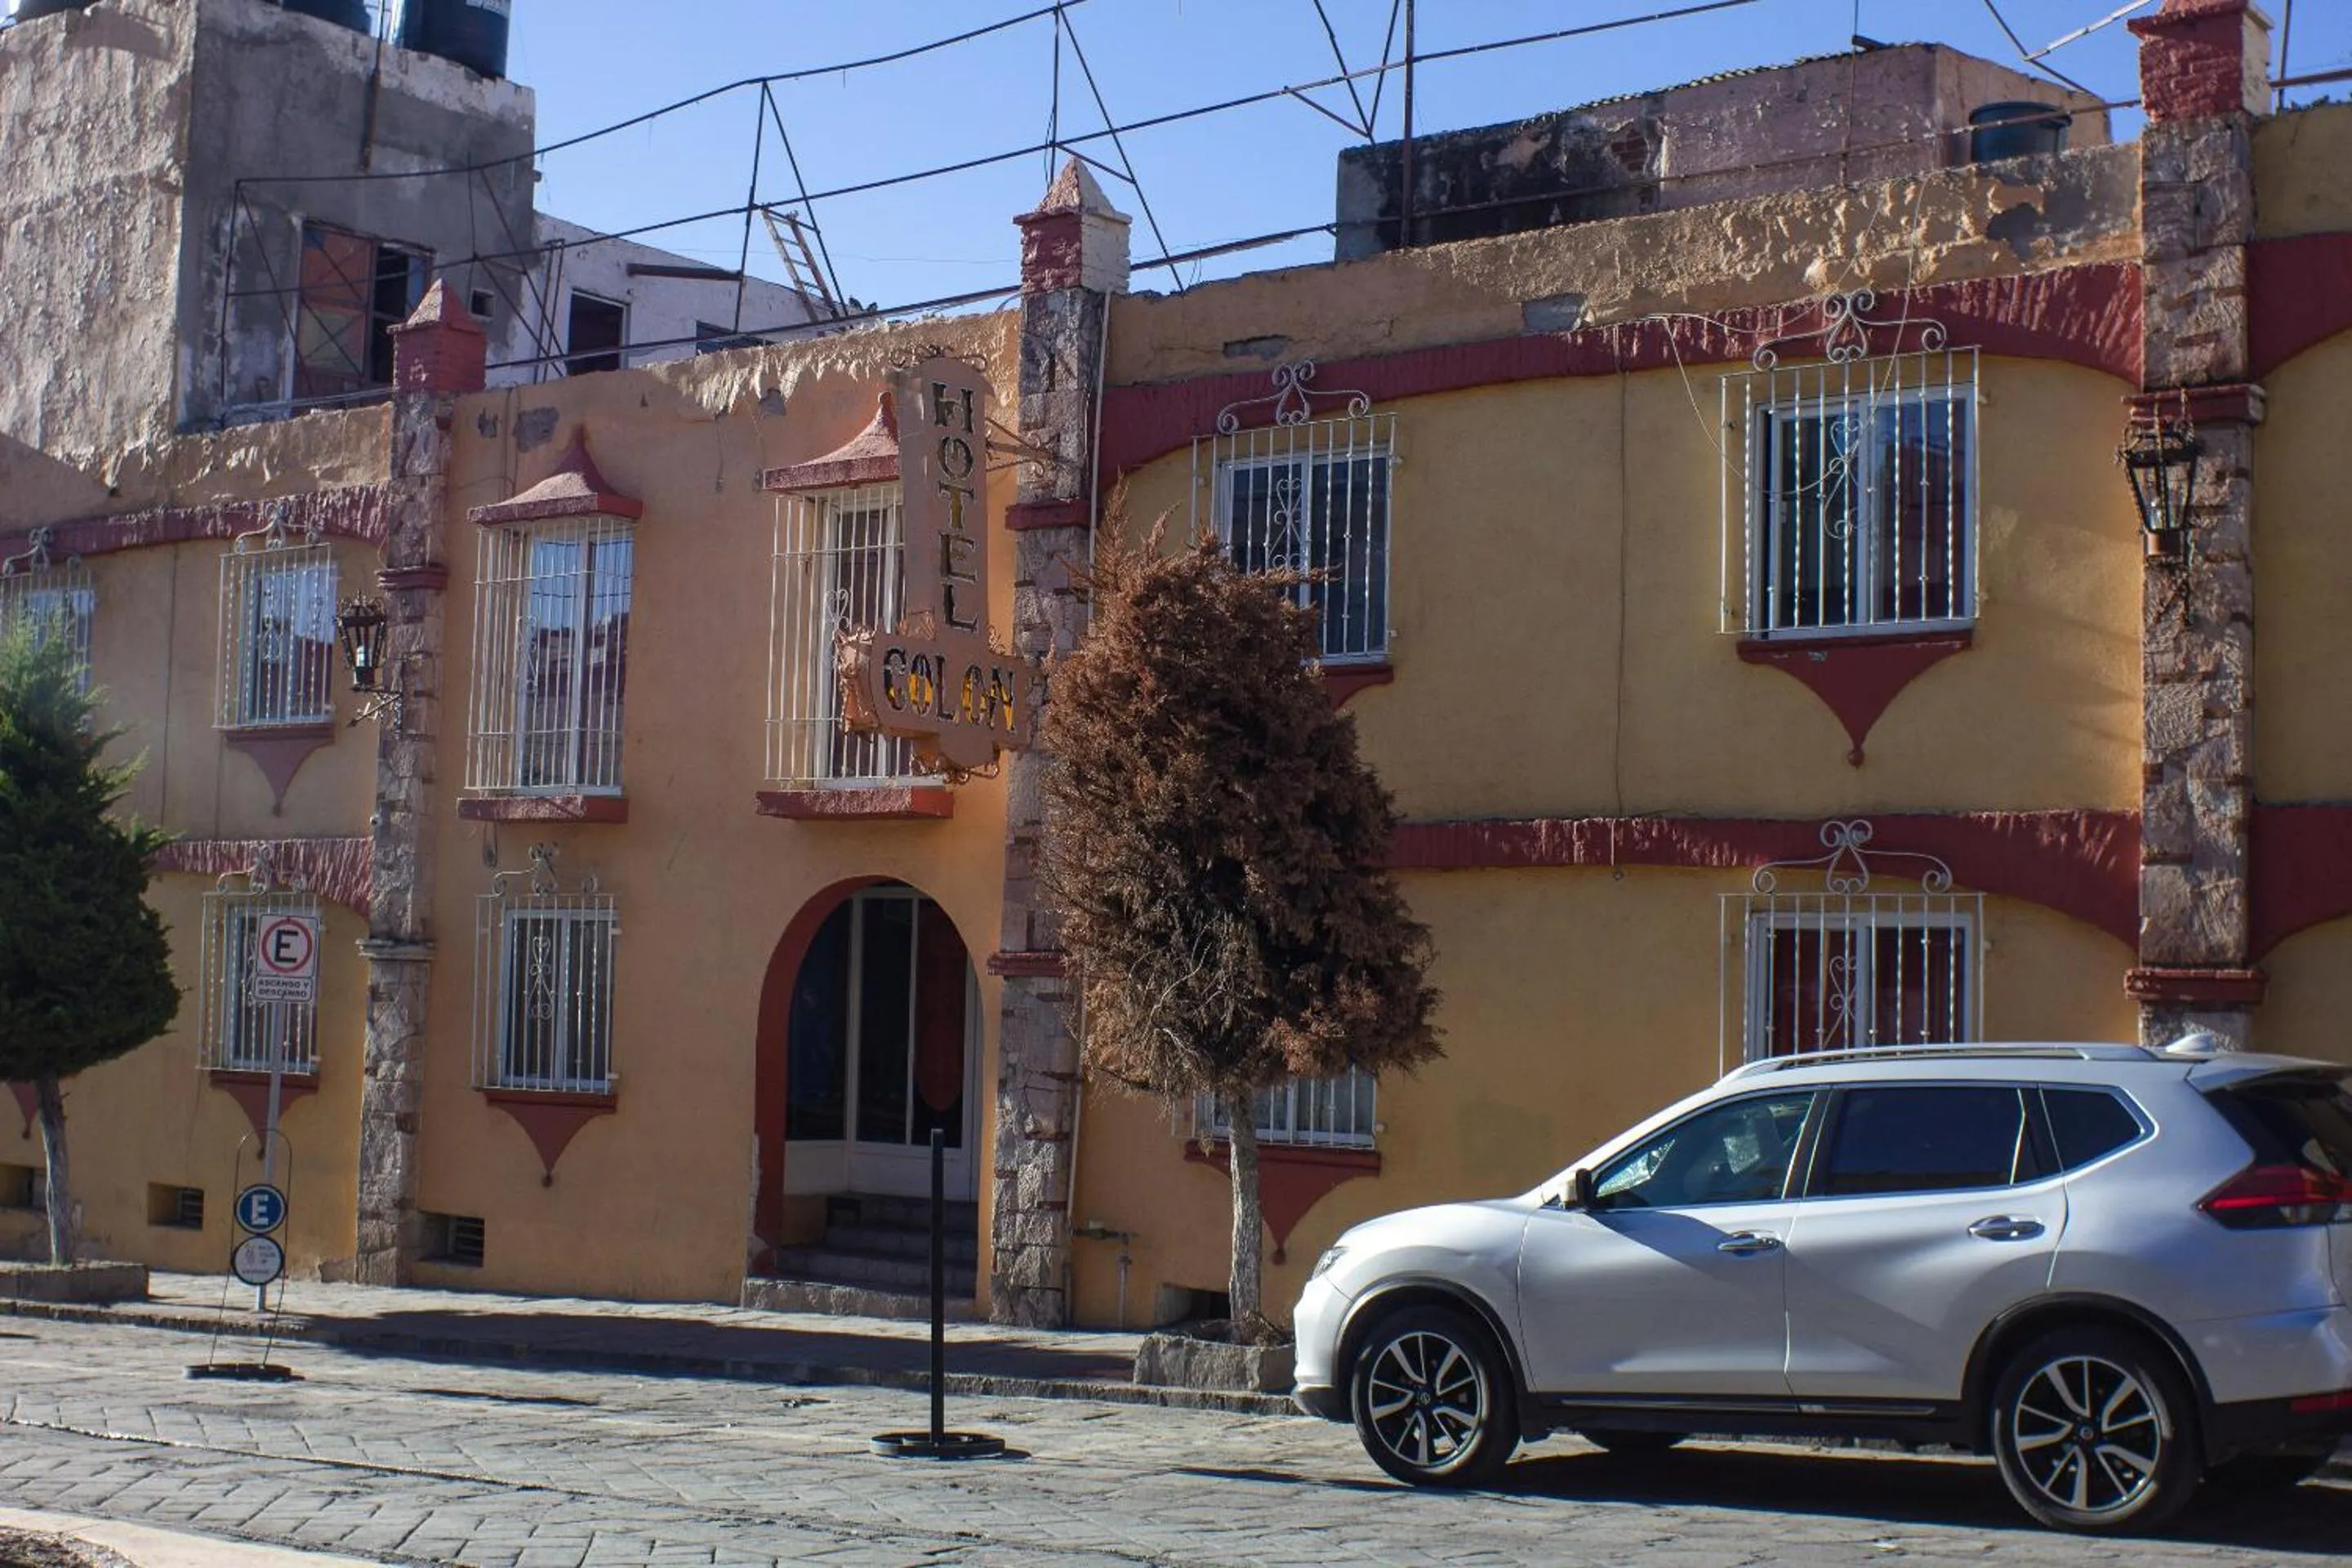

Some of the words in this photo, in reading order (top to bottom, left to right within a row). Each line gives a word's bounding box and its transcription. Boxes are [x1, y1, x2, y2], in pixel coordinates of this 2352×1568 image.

[932, 381, 978, 634] HOTEL
[274, 929, 298, 963] E
[252, 1194, 270, 1225] E
